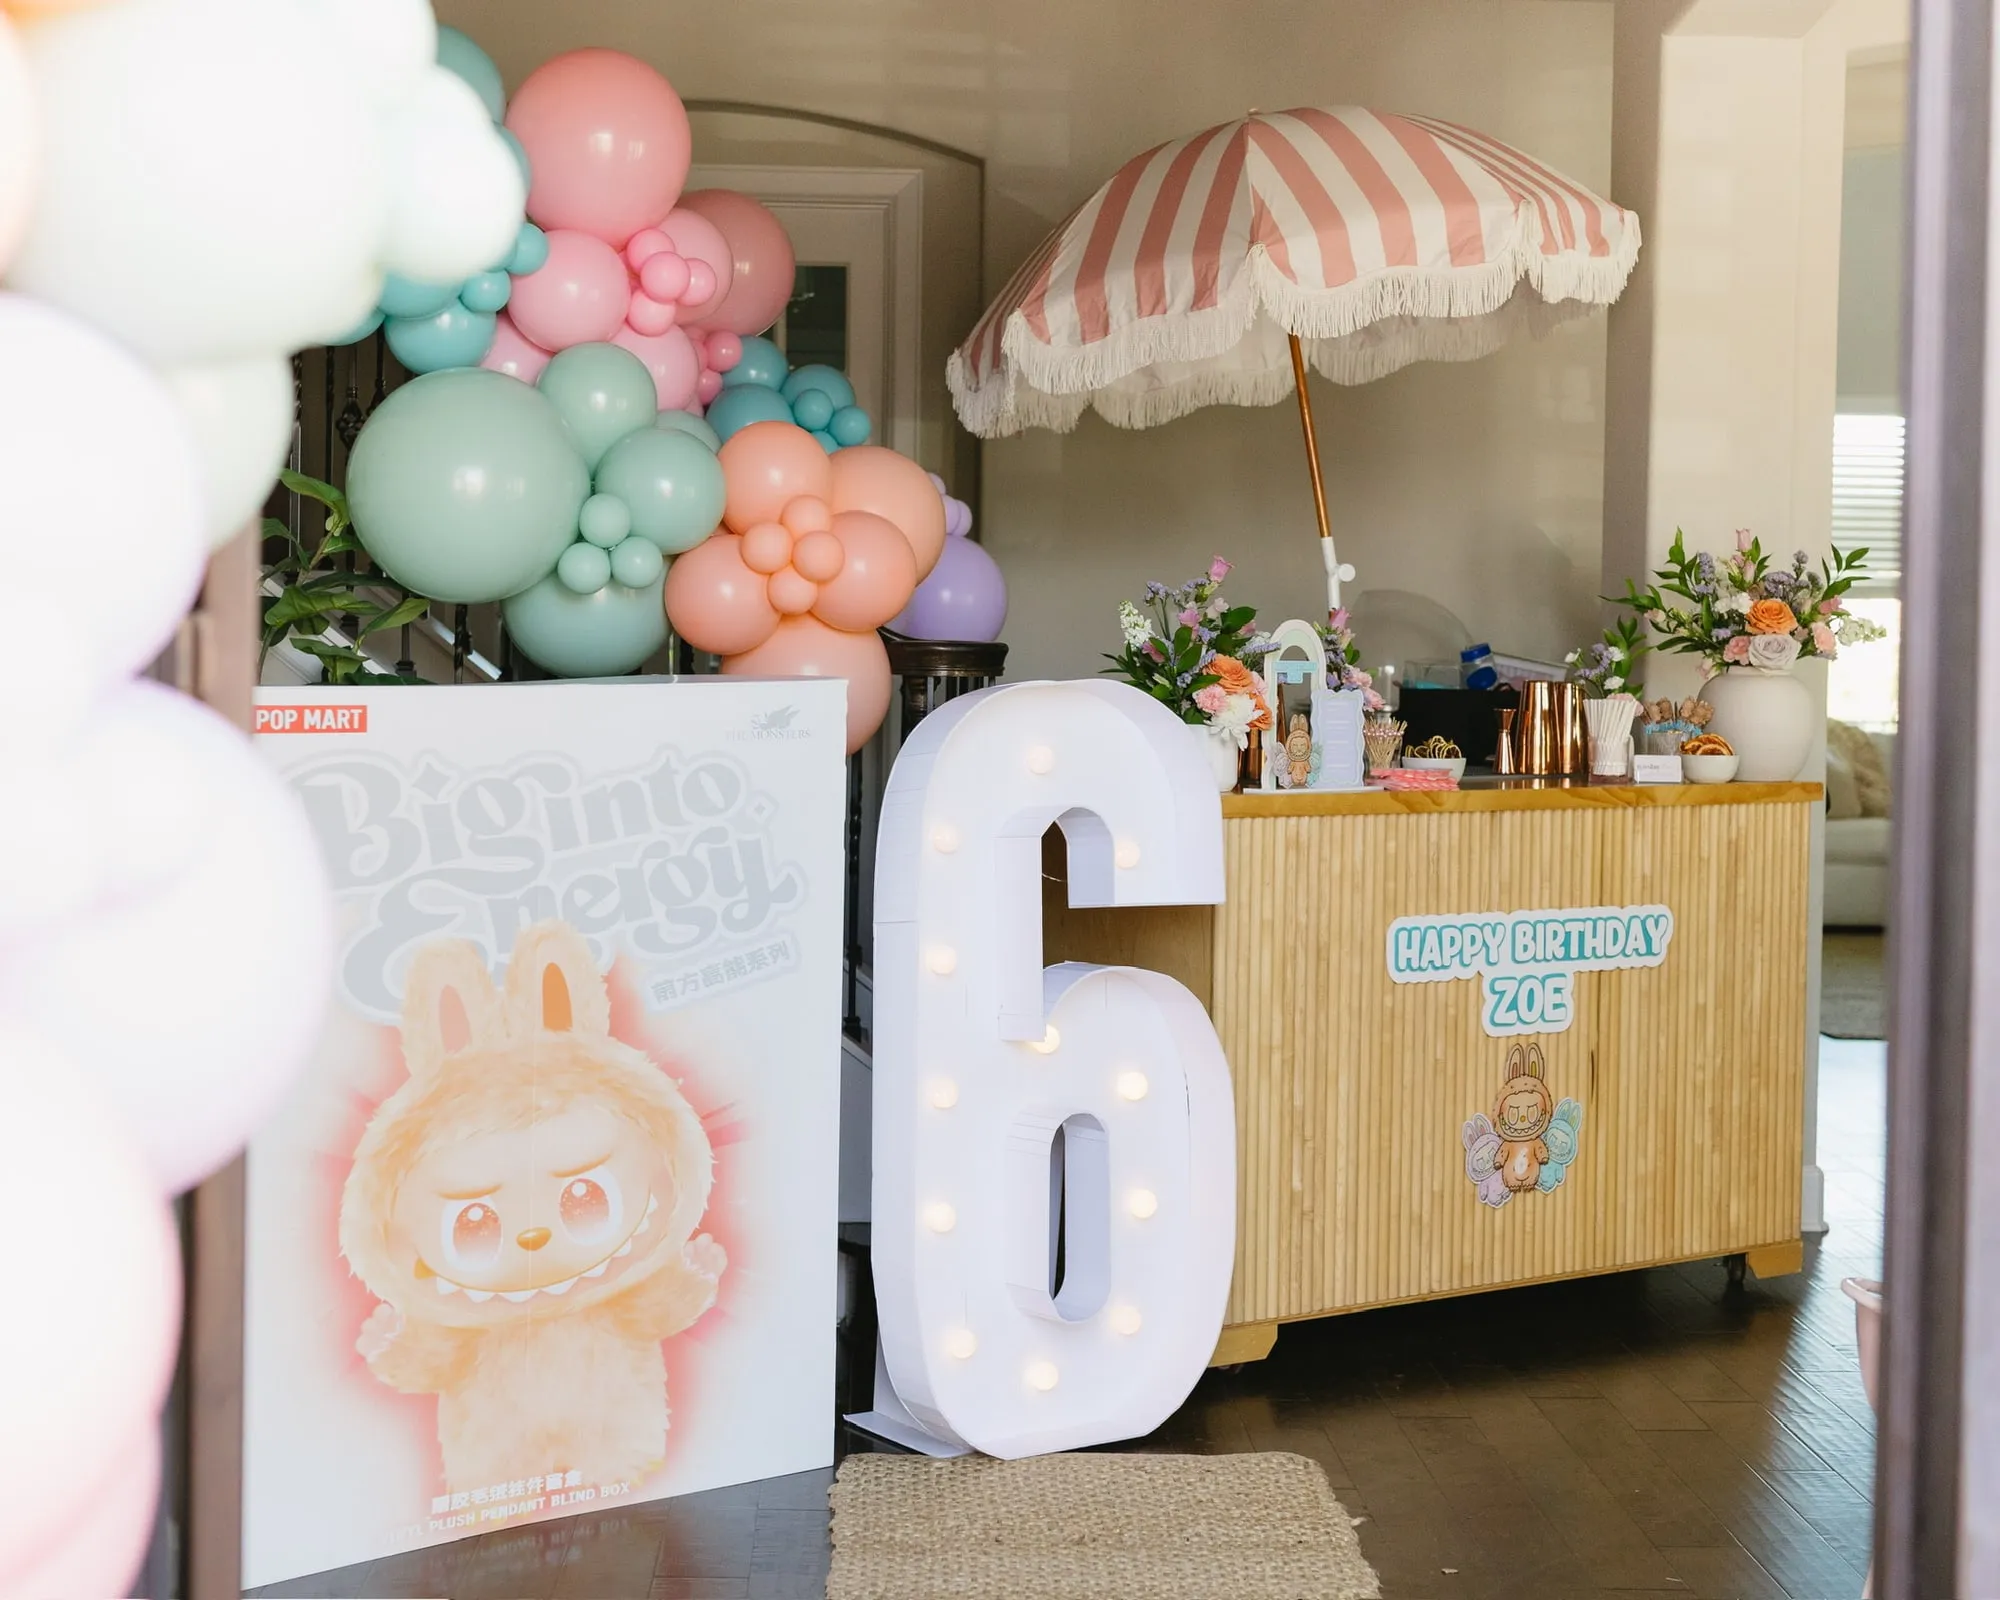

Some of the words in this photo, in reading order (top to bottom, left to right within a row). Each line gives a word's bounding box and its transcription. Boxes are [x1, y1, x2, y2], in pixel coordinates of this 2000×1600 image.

[256, 709, 298, 730] POP
[303, 709, 363, 730] MART
[1394, 922, 1506, 972] HAPPY
[1511, 914, 1669, 964] BIRTHDAY
[1489, 973, 1568, 1027] ZOE
[872, 678, 1236, 1460] 6
[429, 1514, 475, 1532] PLUSH
[481, 1496, 546, 1522] PENDANT
[551, 1488, 596, 1508] BLIND
[601, 1481, 630, 1498] BOX
